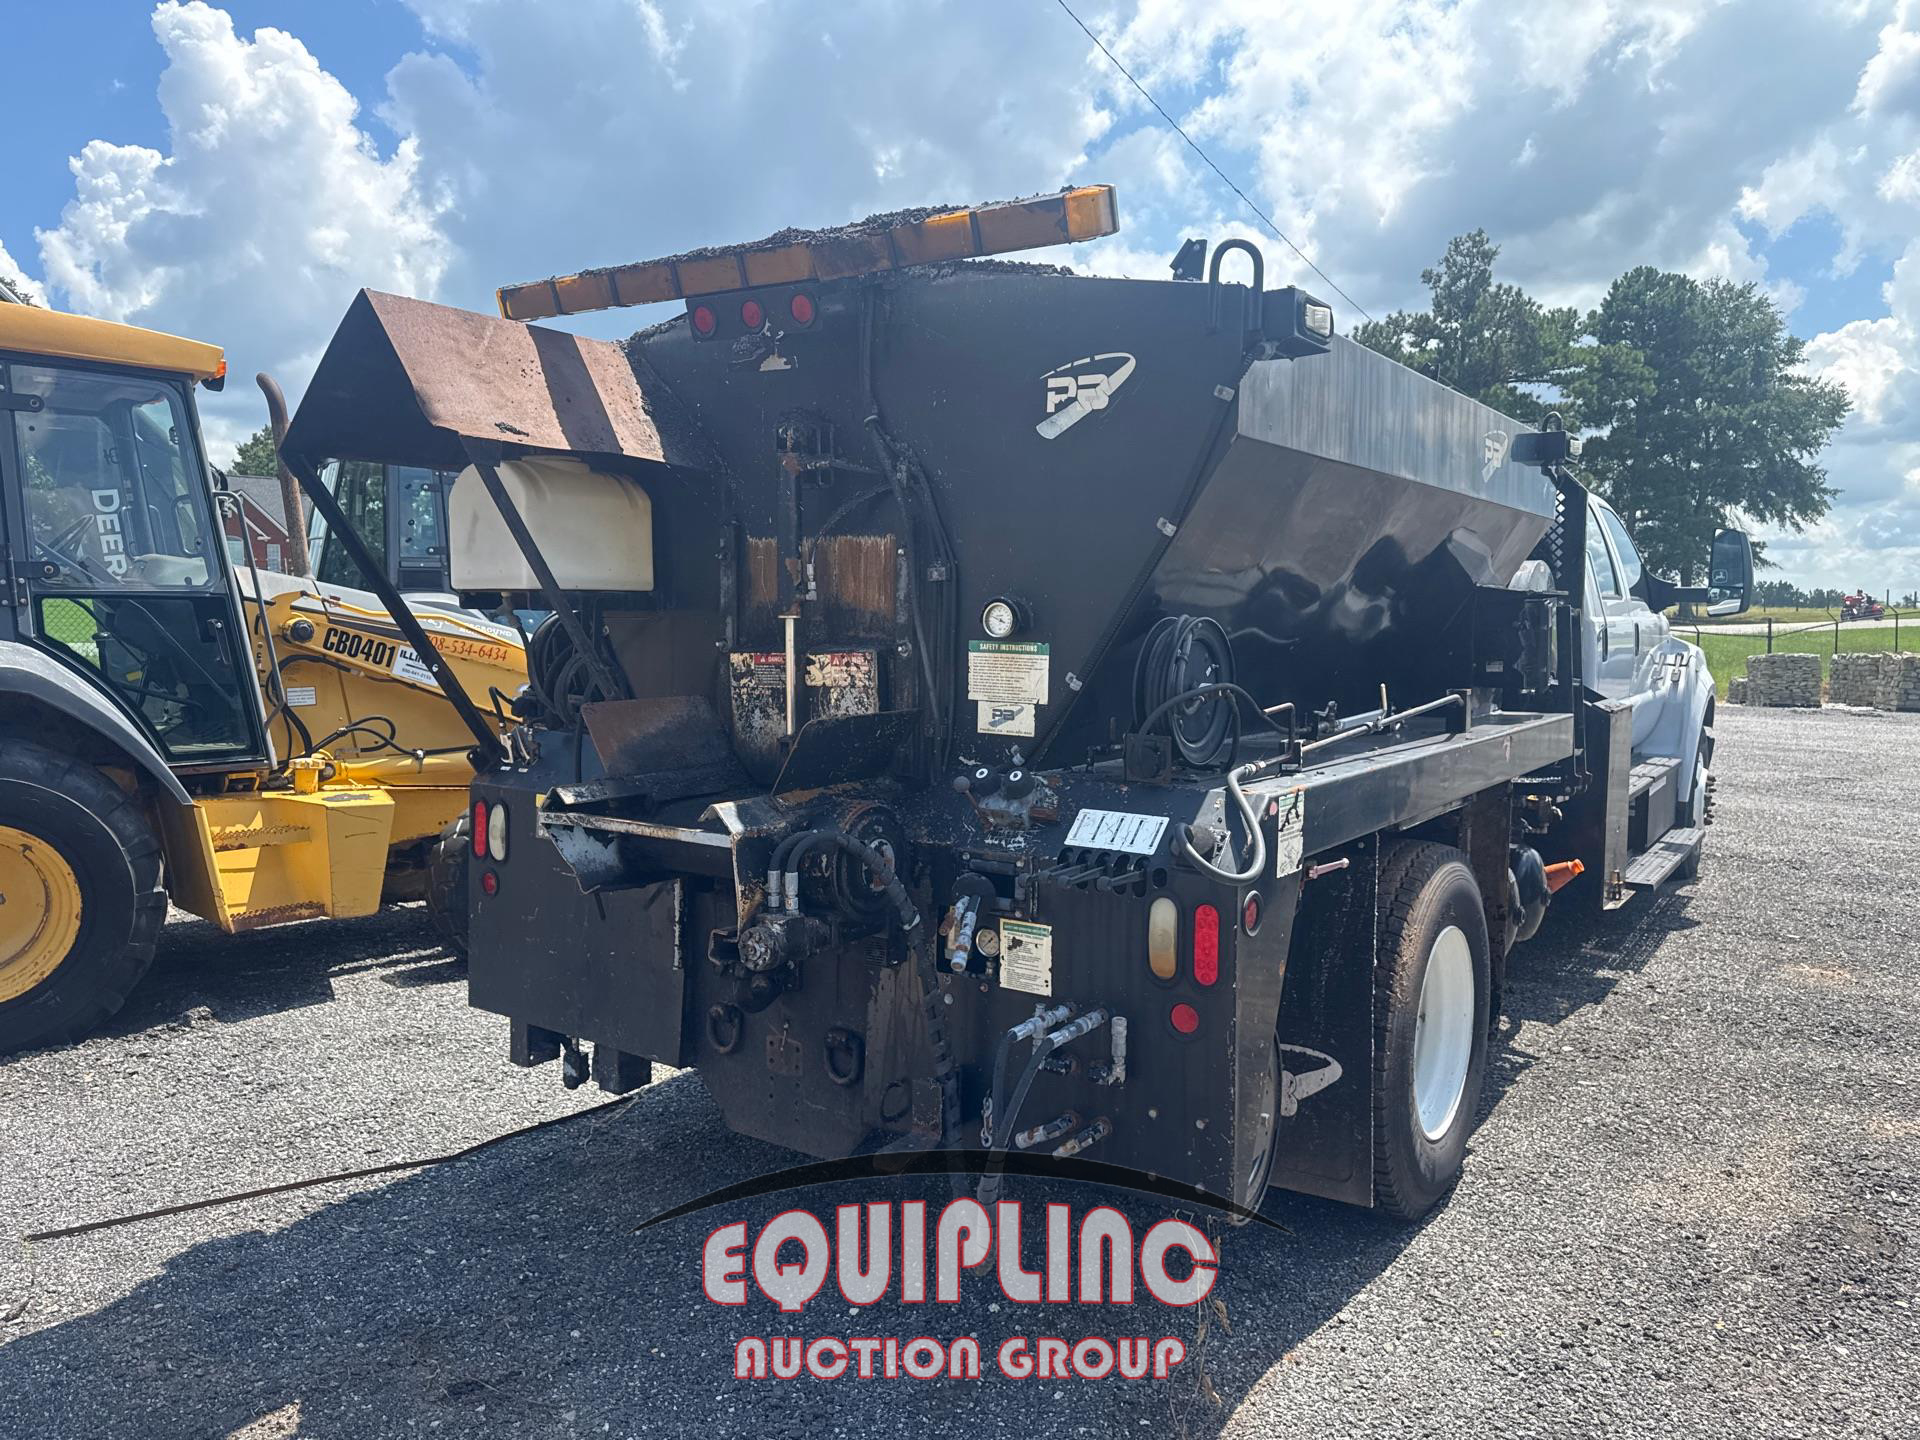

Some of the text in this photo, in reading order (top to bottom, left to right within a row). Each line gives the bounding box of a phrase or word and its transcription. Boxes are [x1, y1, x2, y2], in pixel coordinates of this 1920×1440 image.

[92, 488, 128, 580] DEER
[980, 642, 1038, 652] SAFETY INSTRUCTIONS
